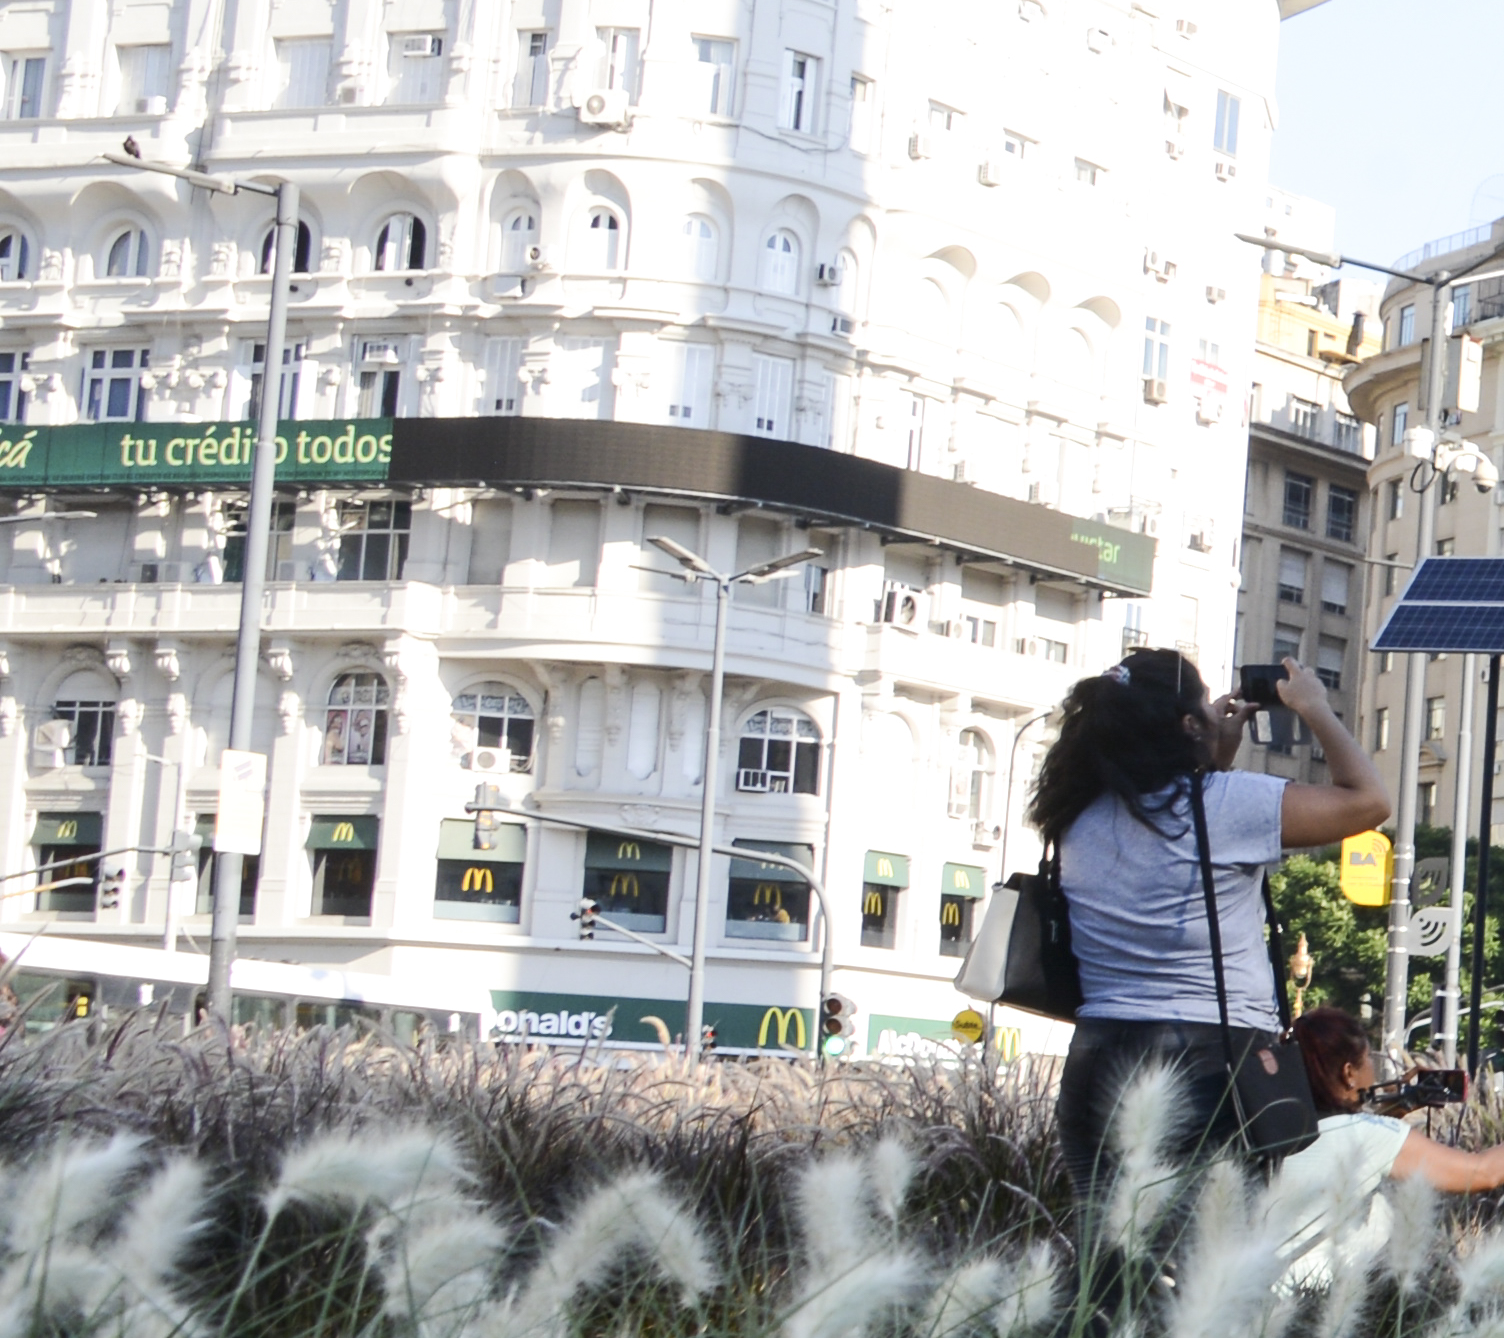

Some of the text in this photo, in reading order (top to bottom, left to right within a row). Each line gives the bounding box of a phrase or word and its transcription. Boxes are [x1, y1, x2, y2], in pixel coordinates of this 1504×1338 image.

[120, 433, 158, 467] tu
[164, 425, 289, 467] crédio
[297, 423, 393, 465] todos
[484, 1009, 613, 1037] onald's
